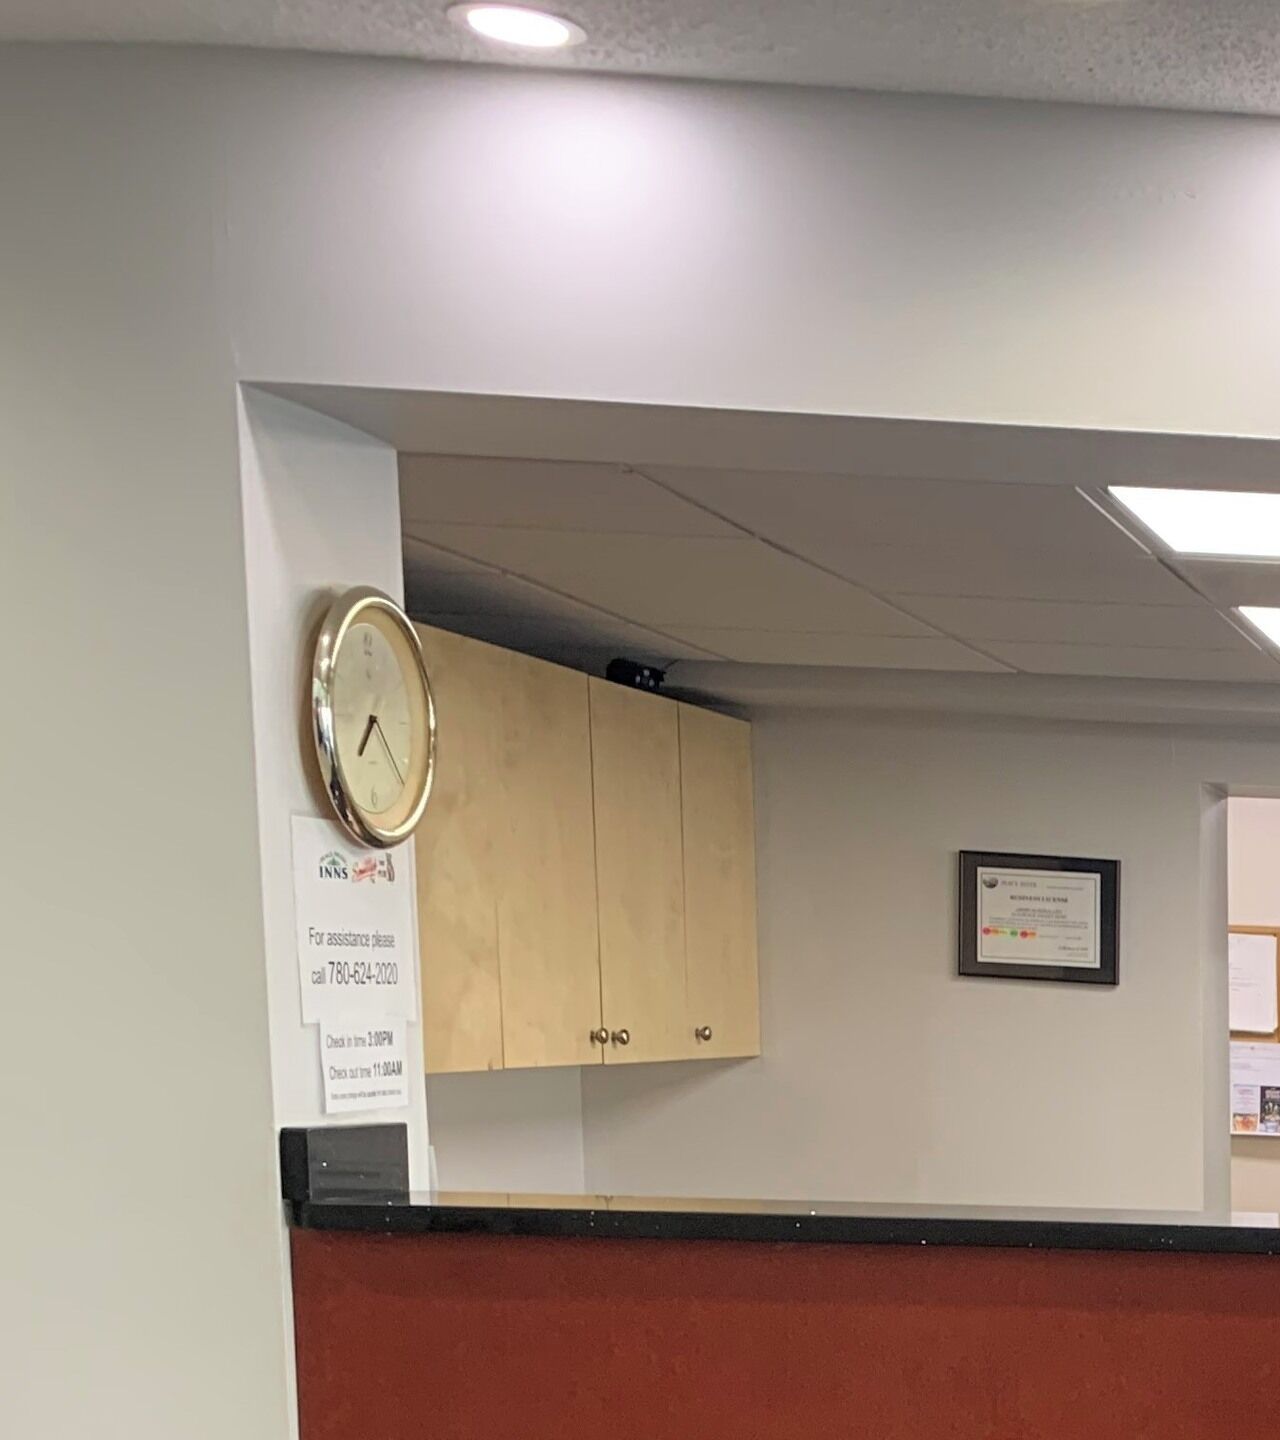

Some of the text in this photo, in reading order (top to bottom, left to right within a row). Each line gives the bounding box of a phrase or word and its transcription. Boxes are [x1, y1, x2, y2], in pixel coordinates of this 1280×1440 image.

[308, 926, 396, 952] For assistance please
[311, 960, 399, 985] call 780-624-2020
